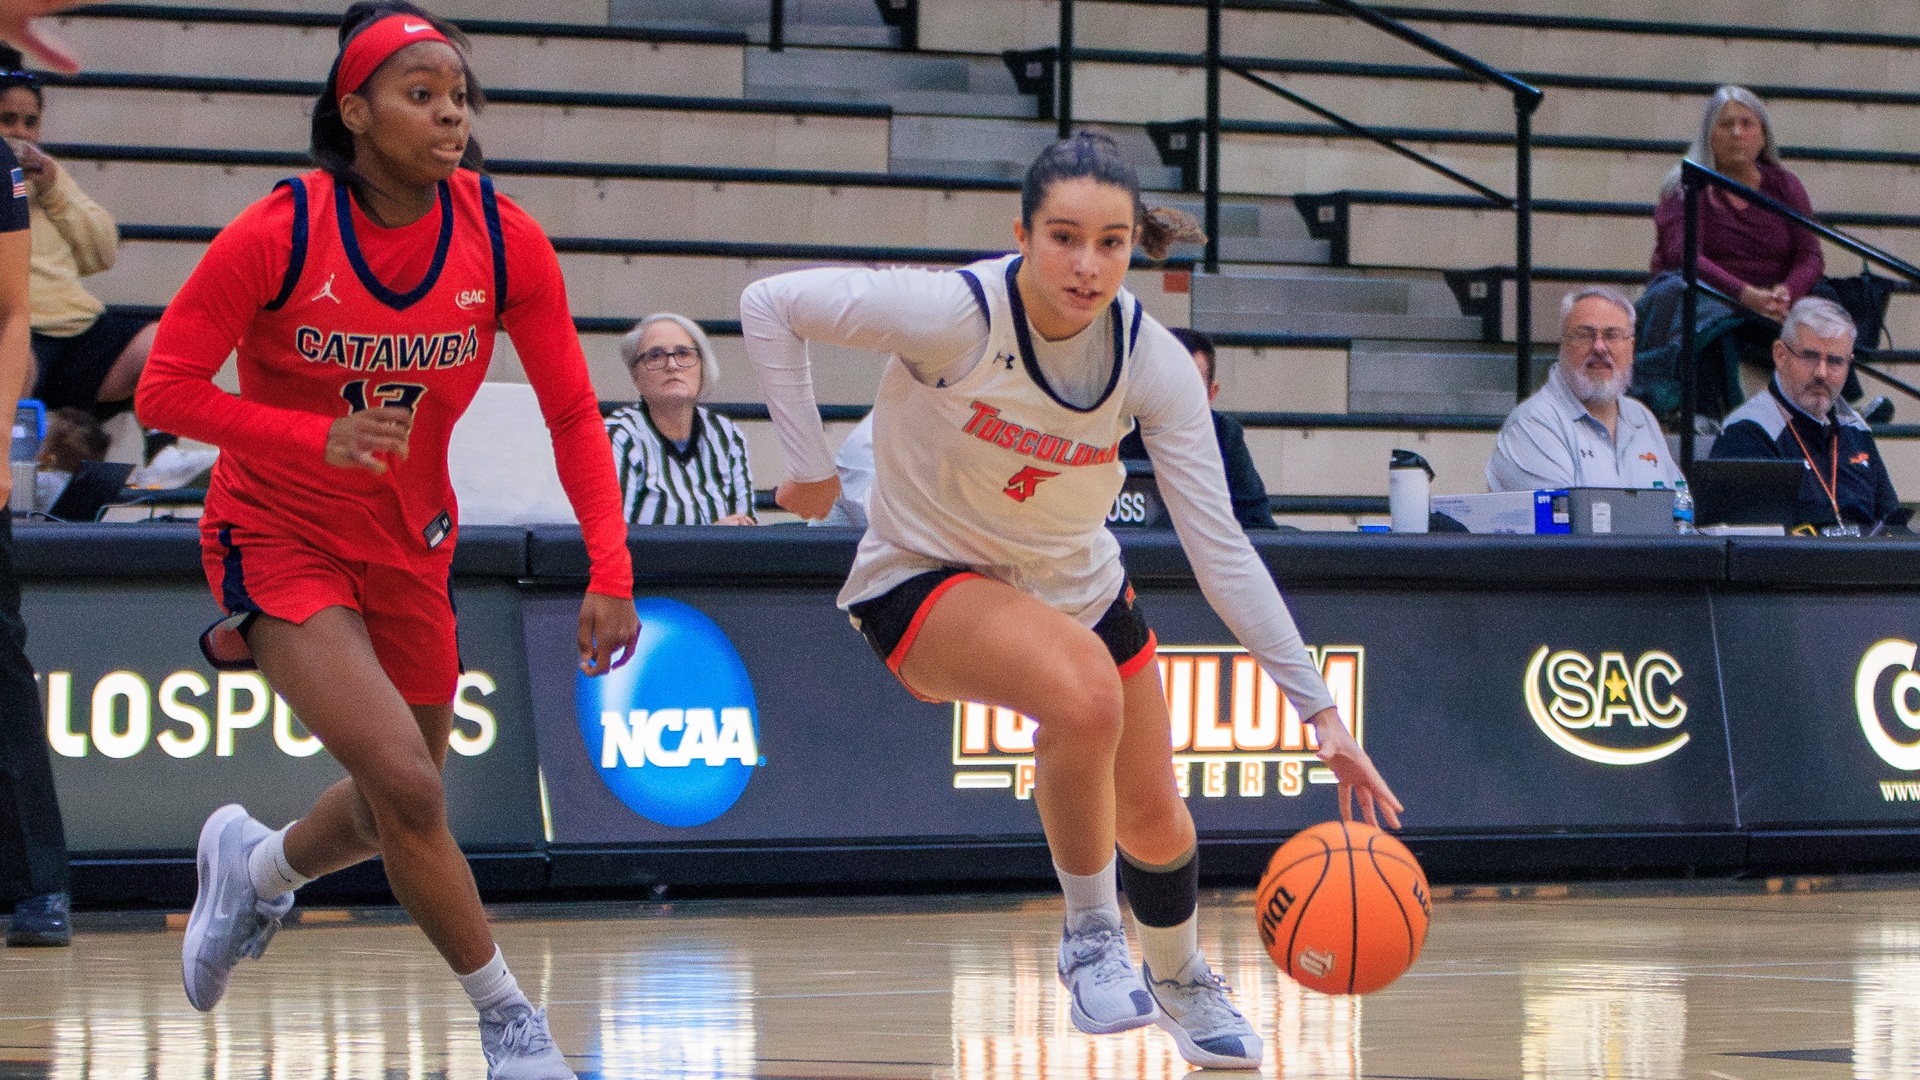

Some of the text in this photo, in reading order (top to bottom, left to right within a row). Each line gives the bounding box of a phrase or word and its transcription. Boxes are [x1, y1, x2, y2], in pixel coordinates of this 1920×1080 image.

[461, 290, 486, 306] SAC
[296, 324, 478, 373] CATAWBA
[46, 670, 498, 759] LOSPS
[1547, 650, 1689, 730] SAC
[601, 708, 758, 769] NCAA
[1015, 761, 1304, 799] PEERS
